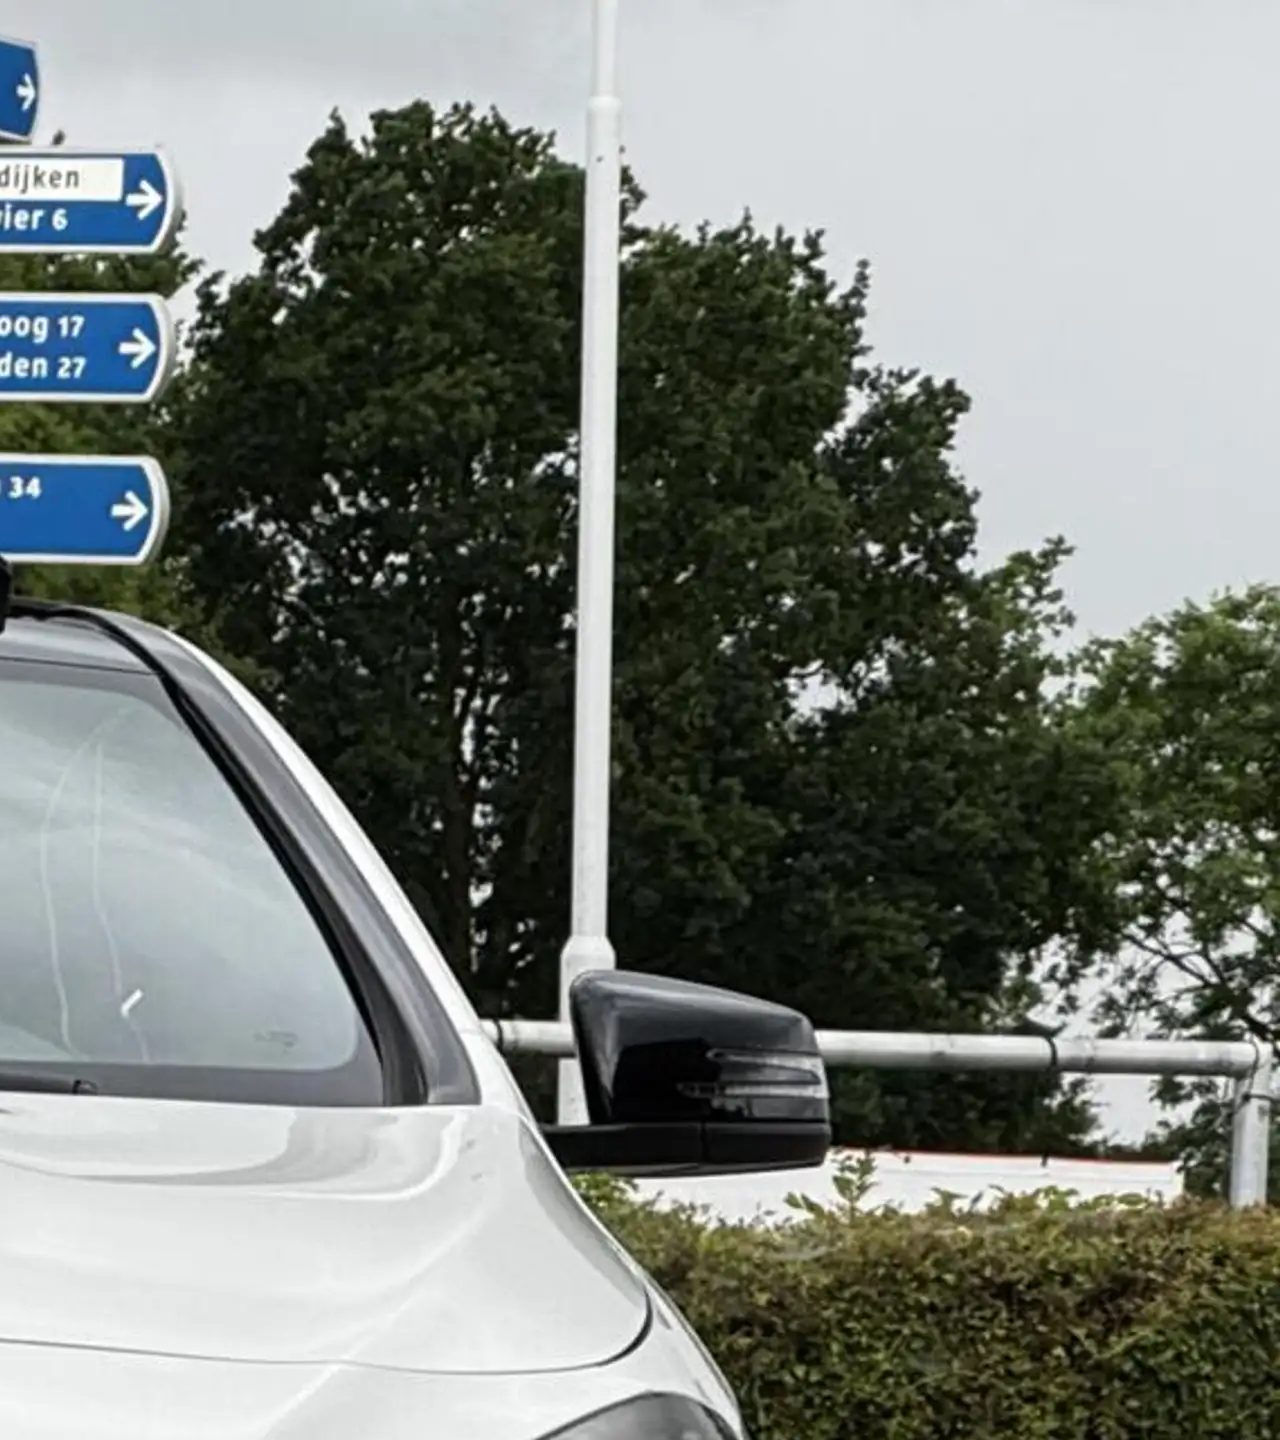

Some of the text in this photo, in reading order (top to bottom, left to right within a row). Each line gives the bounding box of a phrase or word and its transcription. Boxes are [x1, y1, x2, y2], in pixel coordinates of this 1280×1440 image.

[51, 208, 69, 230] 6
[57, 316, 85, 337] 17
[56, 356, 86, 379] 27
[8, 476, 42, 499] 34
